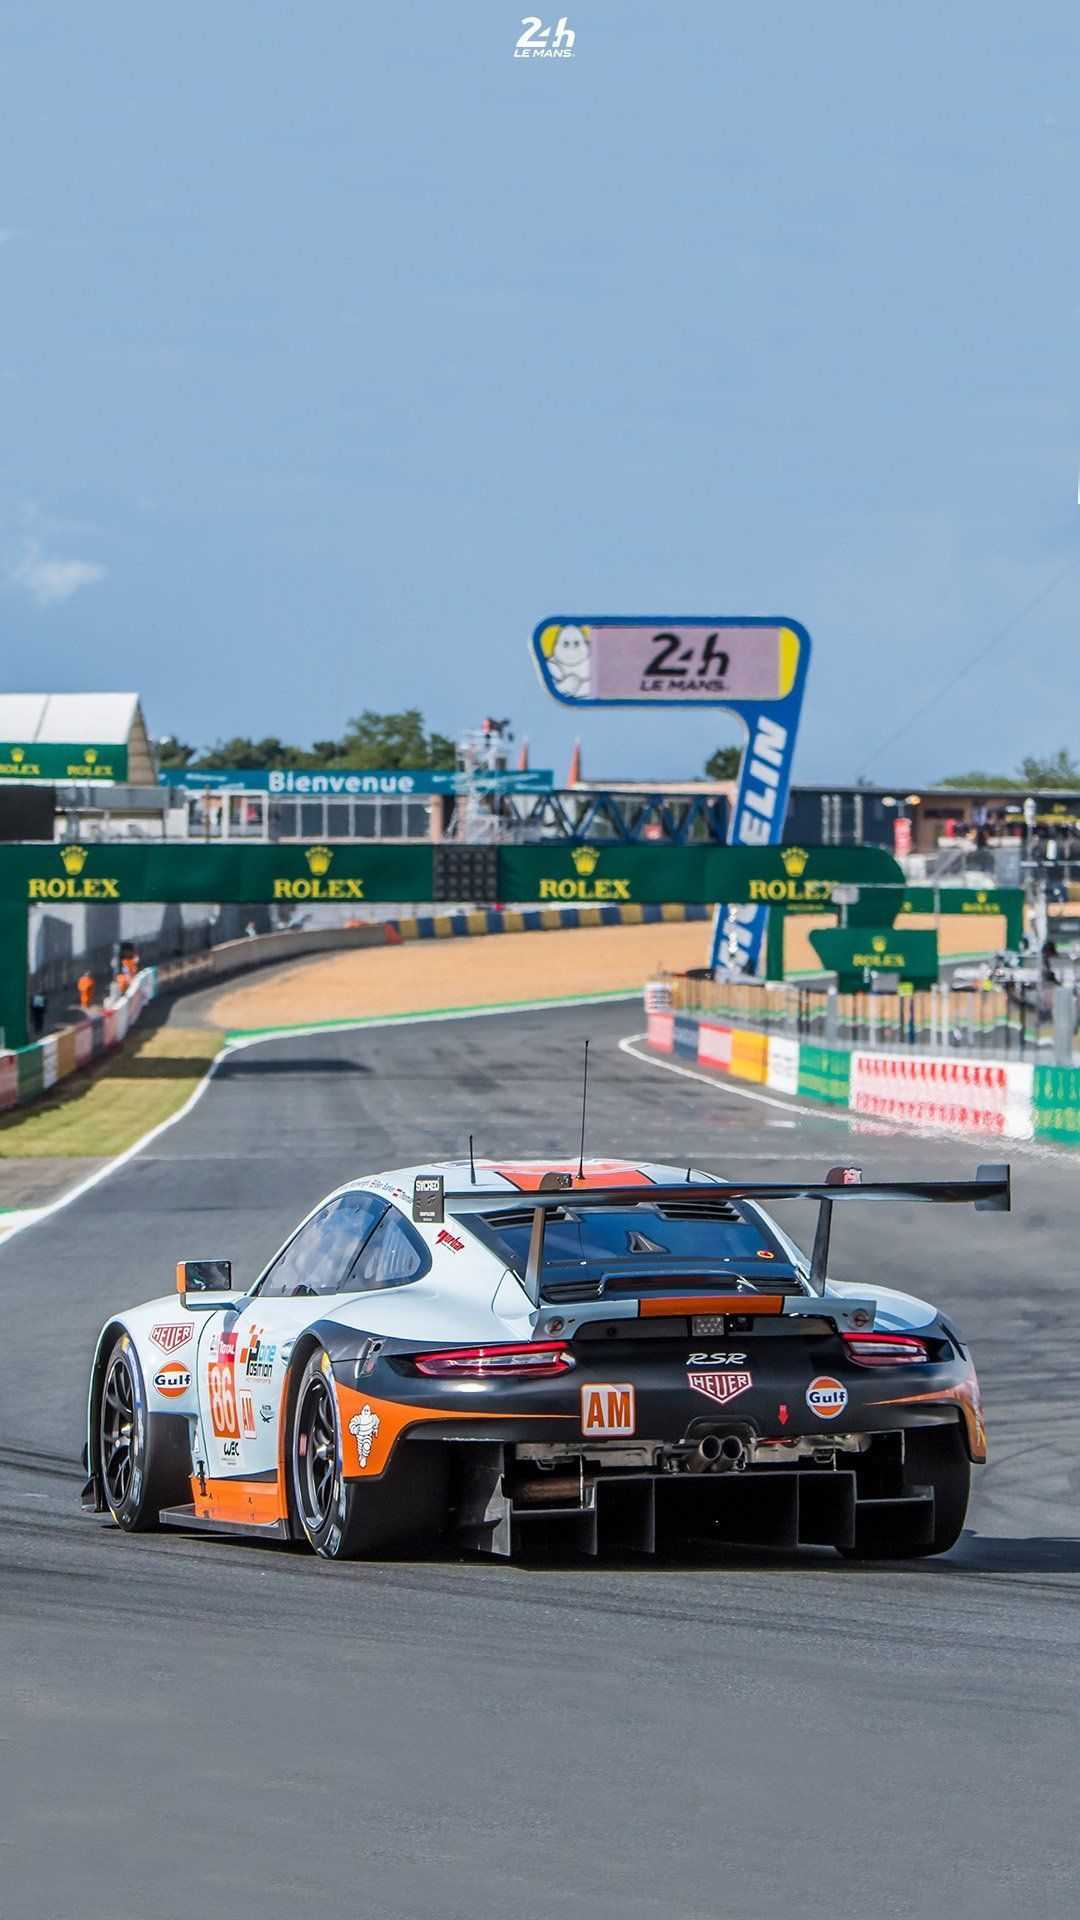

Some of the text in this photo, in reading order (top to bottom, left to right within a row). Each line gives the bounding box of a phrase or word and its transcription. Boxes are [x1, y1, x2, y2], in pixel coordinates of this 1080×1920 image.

[640, 680, 724, 692] LE MANS
[268, 771, 415, 793] Bienvenue
[28, 878, 120, 899] ROLEX
[273, 878, 364, 899] ROLEX
[539, 878, 631, 900] ROLEX
[153, 1328, 192, 1351] HEUER
[685, 1352, 748, 1365] RSR
[155, 1374, 191, 1386] Gulf
[693, 1375, 748, 1398] HEUER
[211, 1366, 236, 1433] 86
[808, 1391, 846, 1404] Gulf
[586, 1391, 631, 1429] AM
[223, 1441, 240, 1456] WEC
